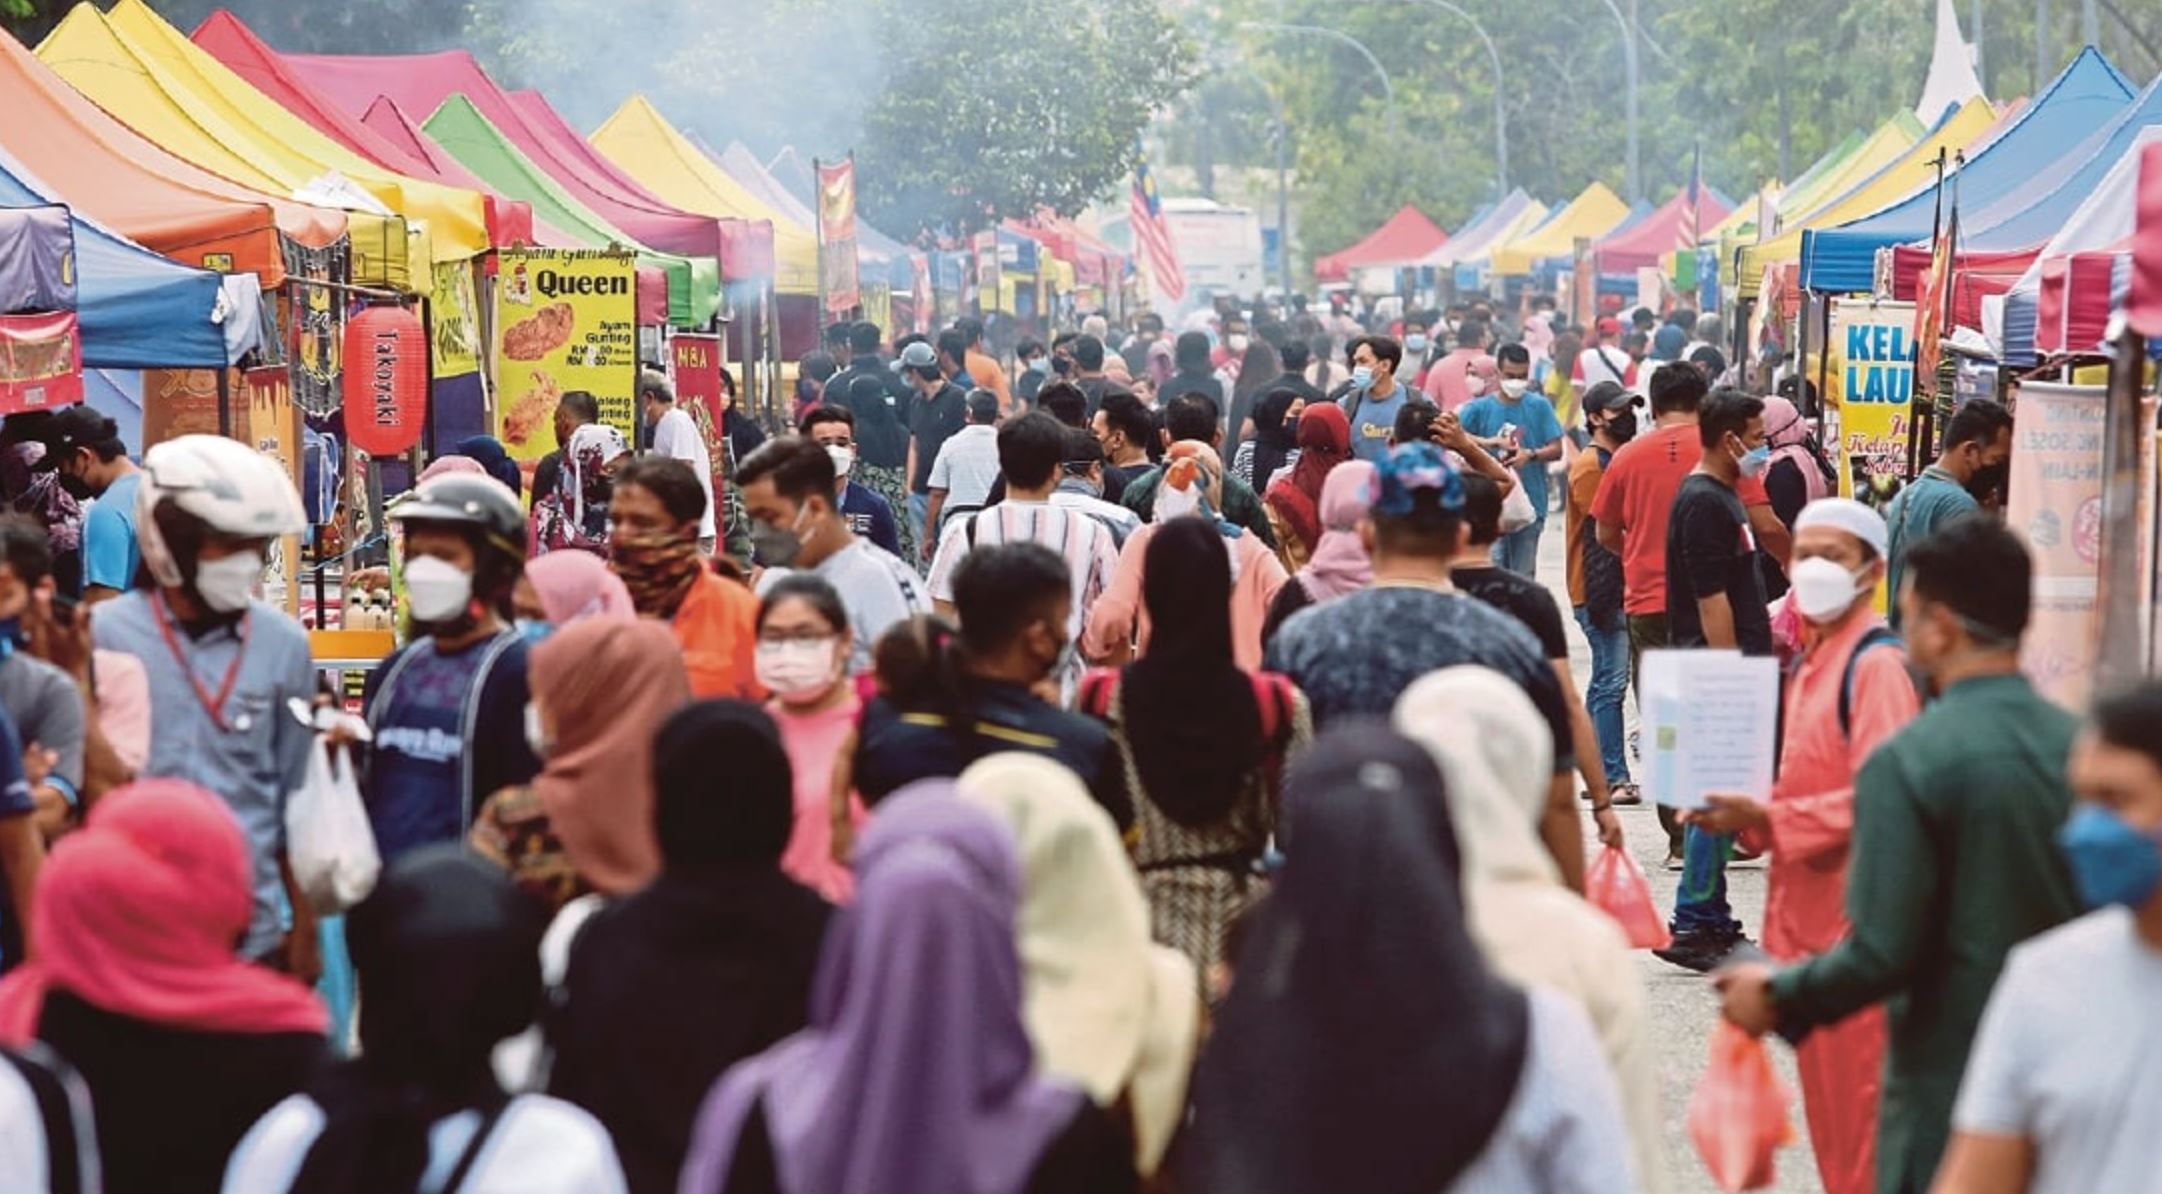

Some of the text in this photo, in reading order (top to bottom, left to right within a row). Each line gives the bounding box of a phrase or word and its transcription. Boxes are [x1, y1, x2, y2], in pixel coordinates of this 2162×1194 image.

[536, 270, 627, 298] Queen
[586, 332, 631, 345] Gunting
[599, 320, 631, 333] Ayam
[374, 331, 399, 426] Takoyaki
[1847, 366, 1910, 404] LAU
